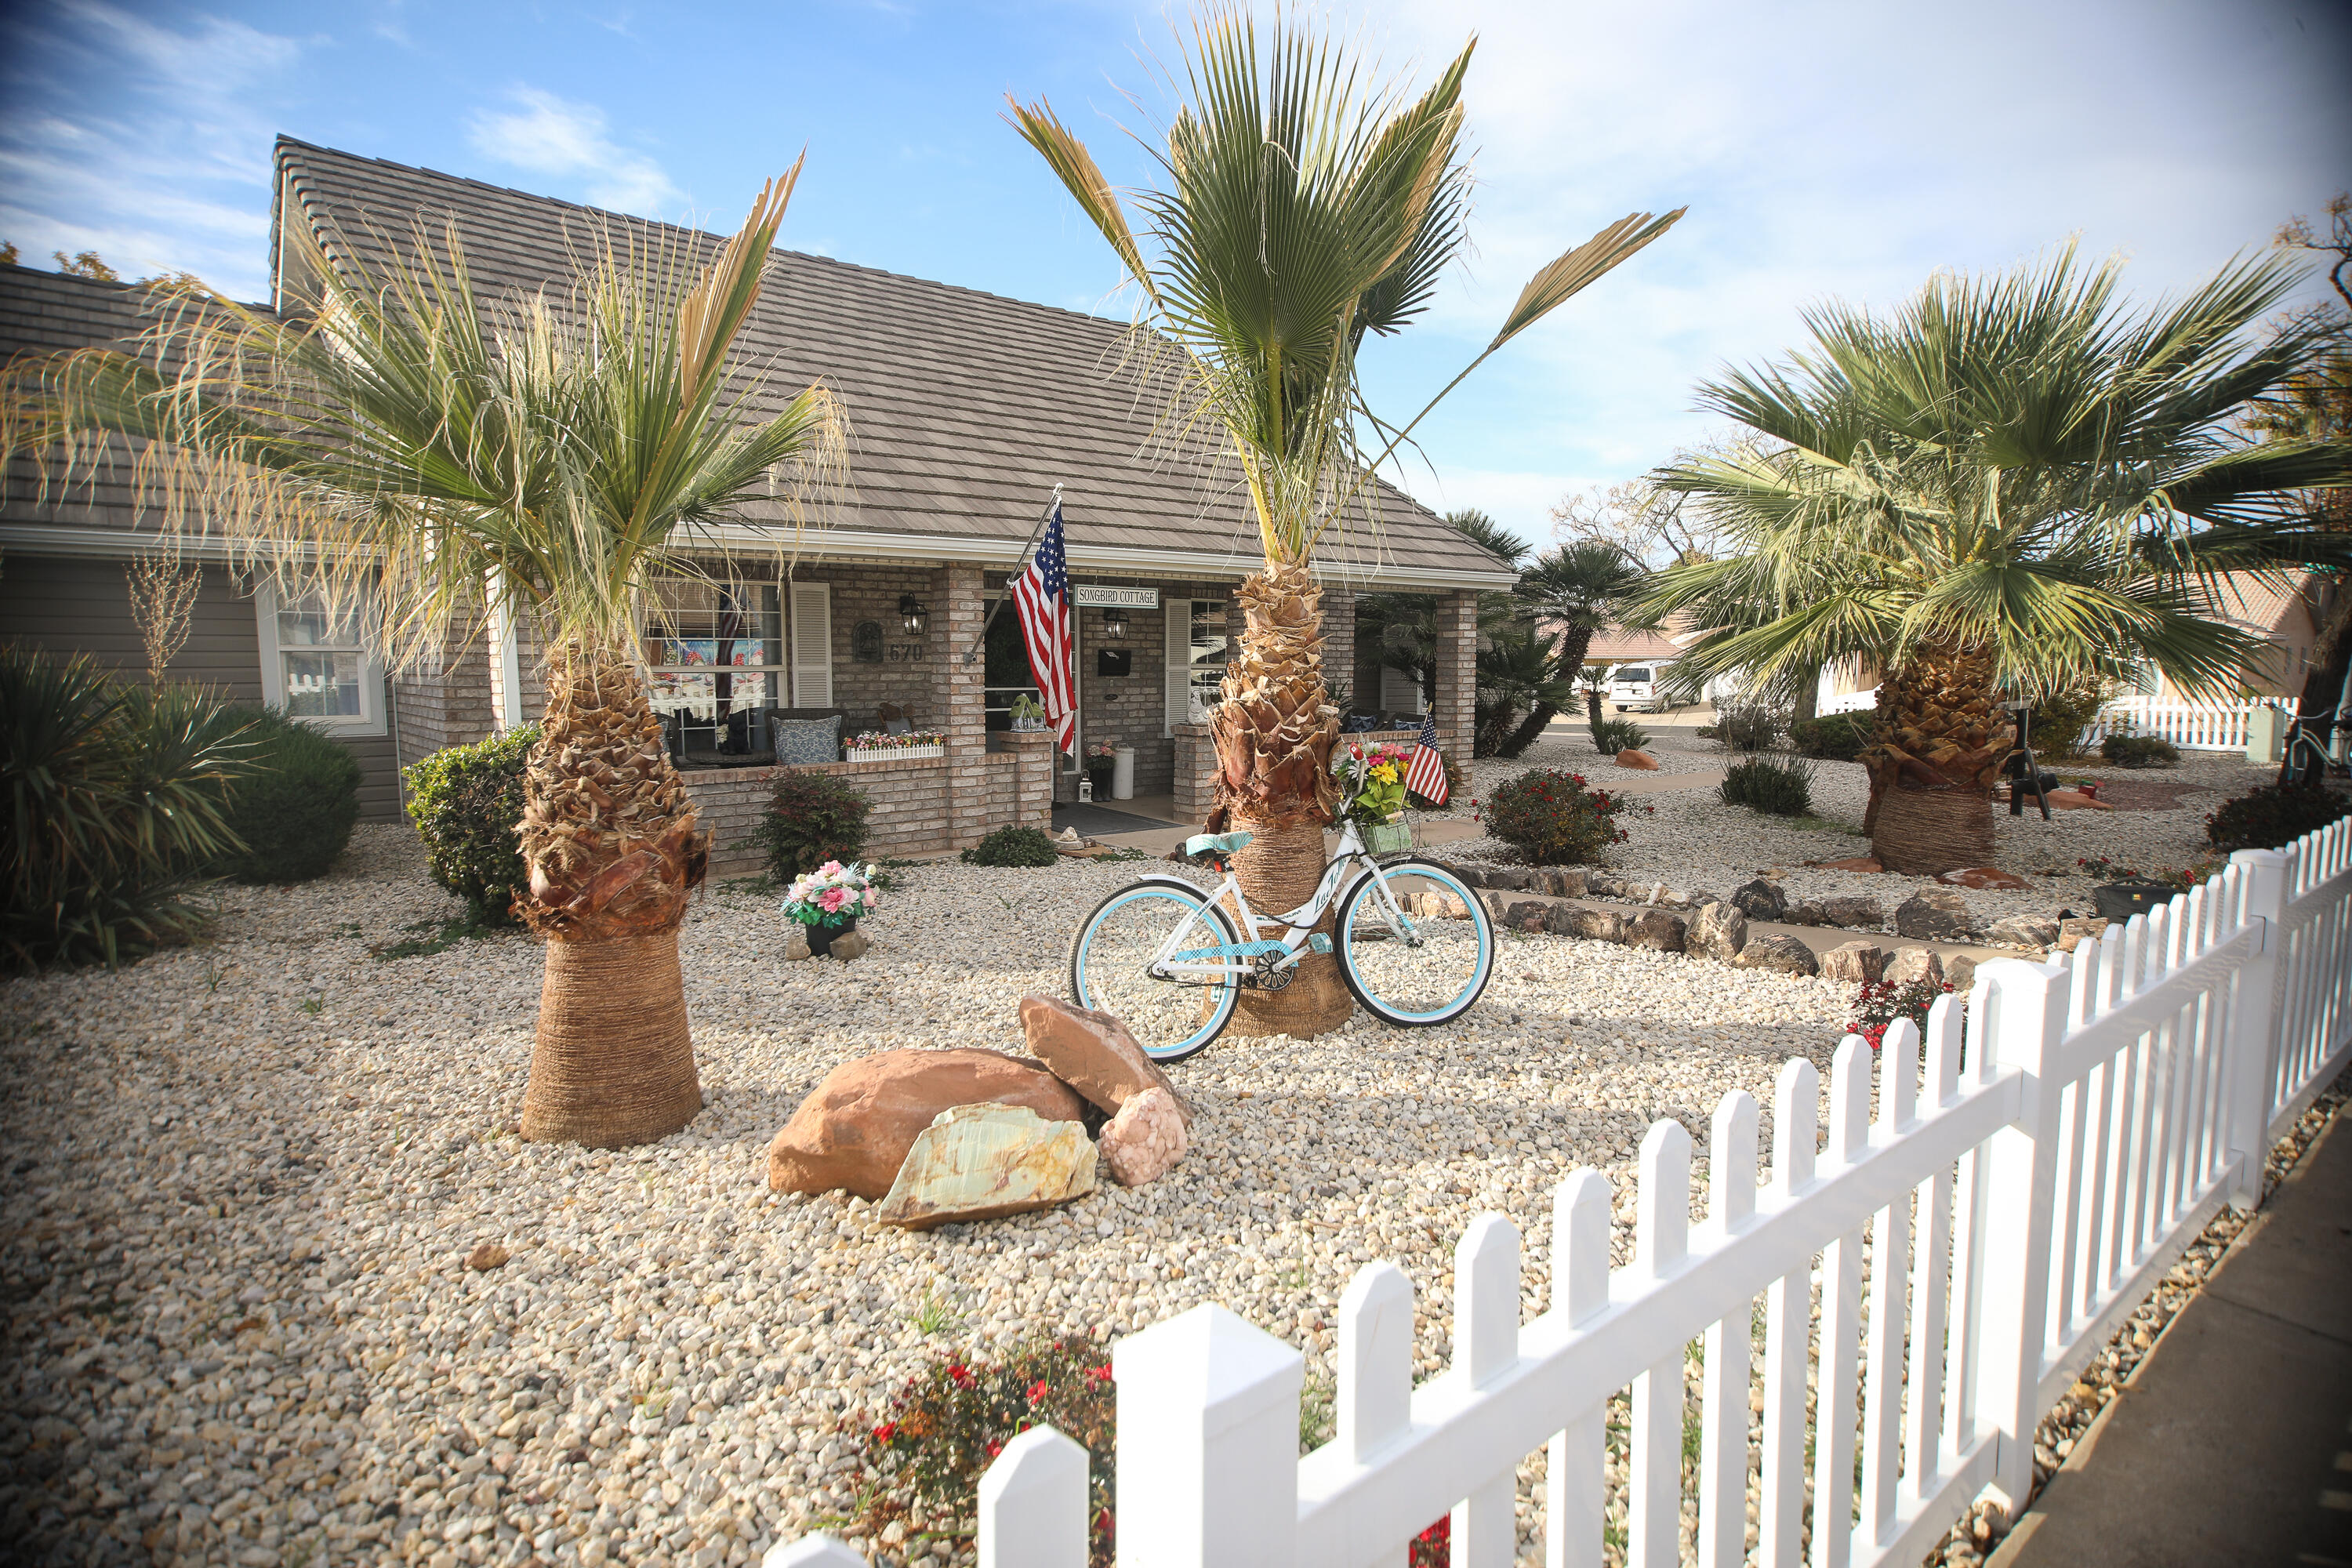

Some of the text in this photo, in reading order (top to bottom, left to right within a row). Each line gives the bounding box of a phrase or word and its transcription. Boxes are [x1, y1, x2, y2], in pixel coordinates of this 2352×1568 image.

[1079, 588, 1155, 604] SONGBIRD COTTAGE
[890, 644, 923, 662] 670
